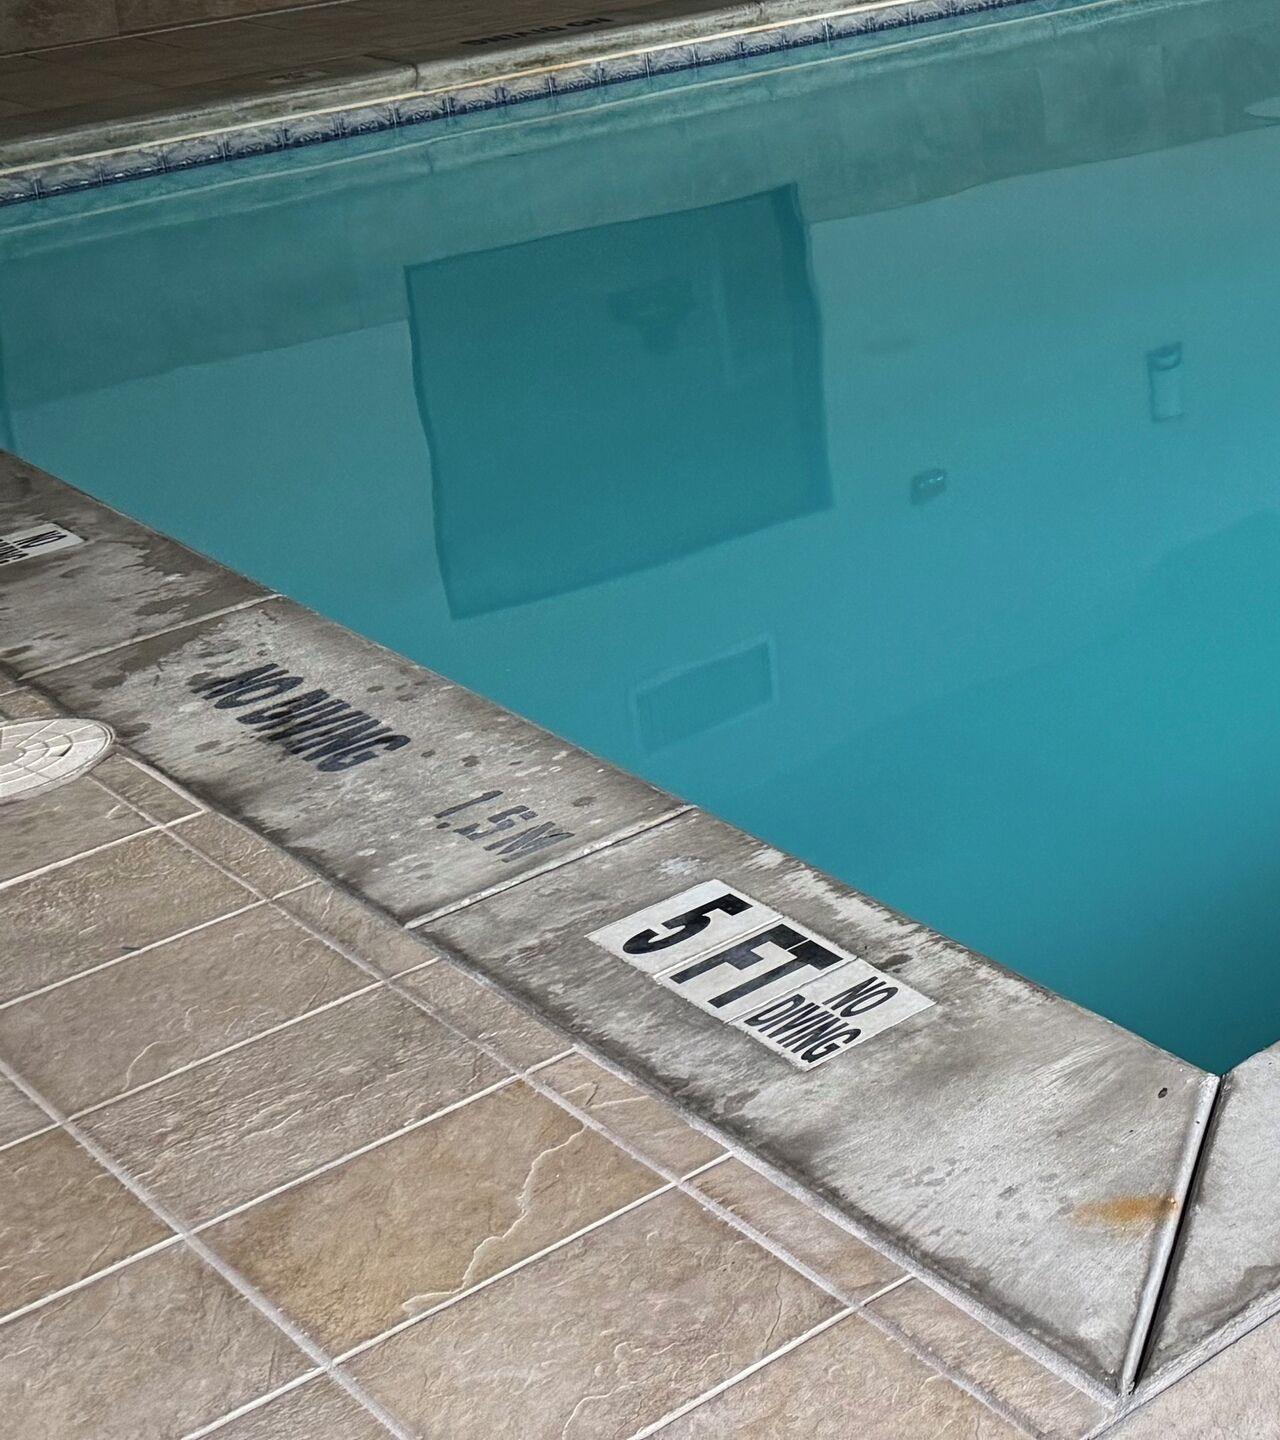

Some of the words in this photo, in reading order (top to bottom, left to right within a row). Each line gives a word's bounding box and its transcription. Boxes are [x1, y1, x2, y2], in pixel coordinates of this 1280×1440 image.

[12, 529, 68, 548] NO
[190, 662, 304, 710] NO
[236, 688, 411, 772] DIVING
[622, 893, 754, 954] 5
[669, 923, 845, 1009] FT
[821, 976, 899, 1017] NO
[744, 994, 861, 1063] DIVING
